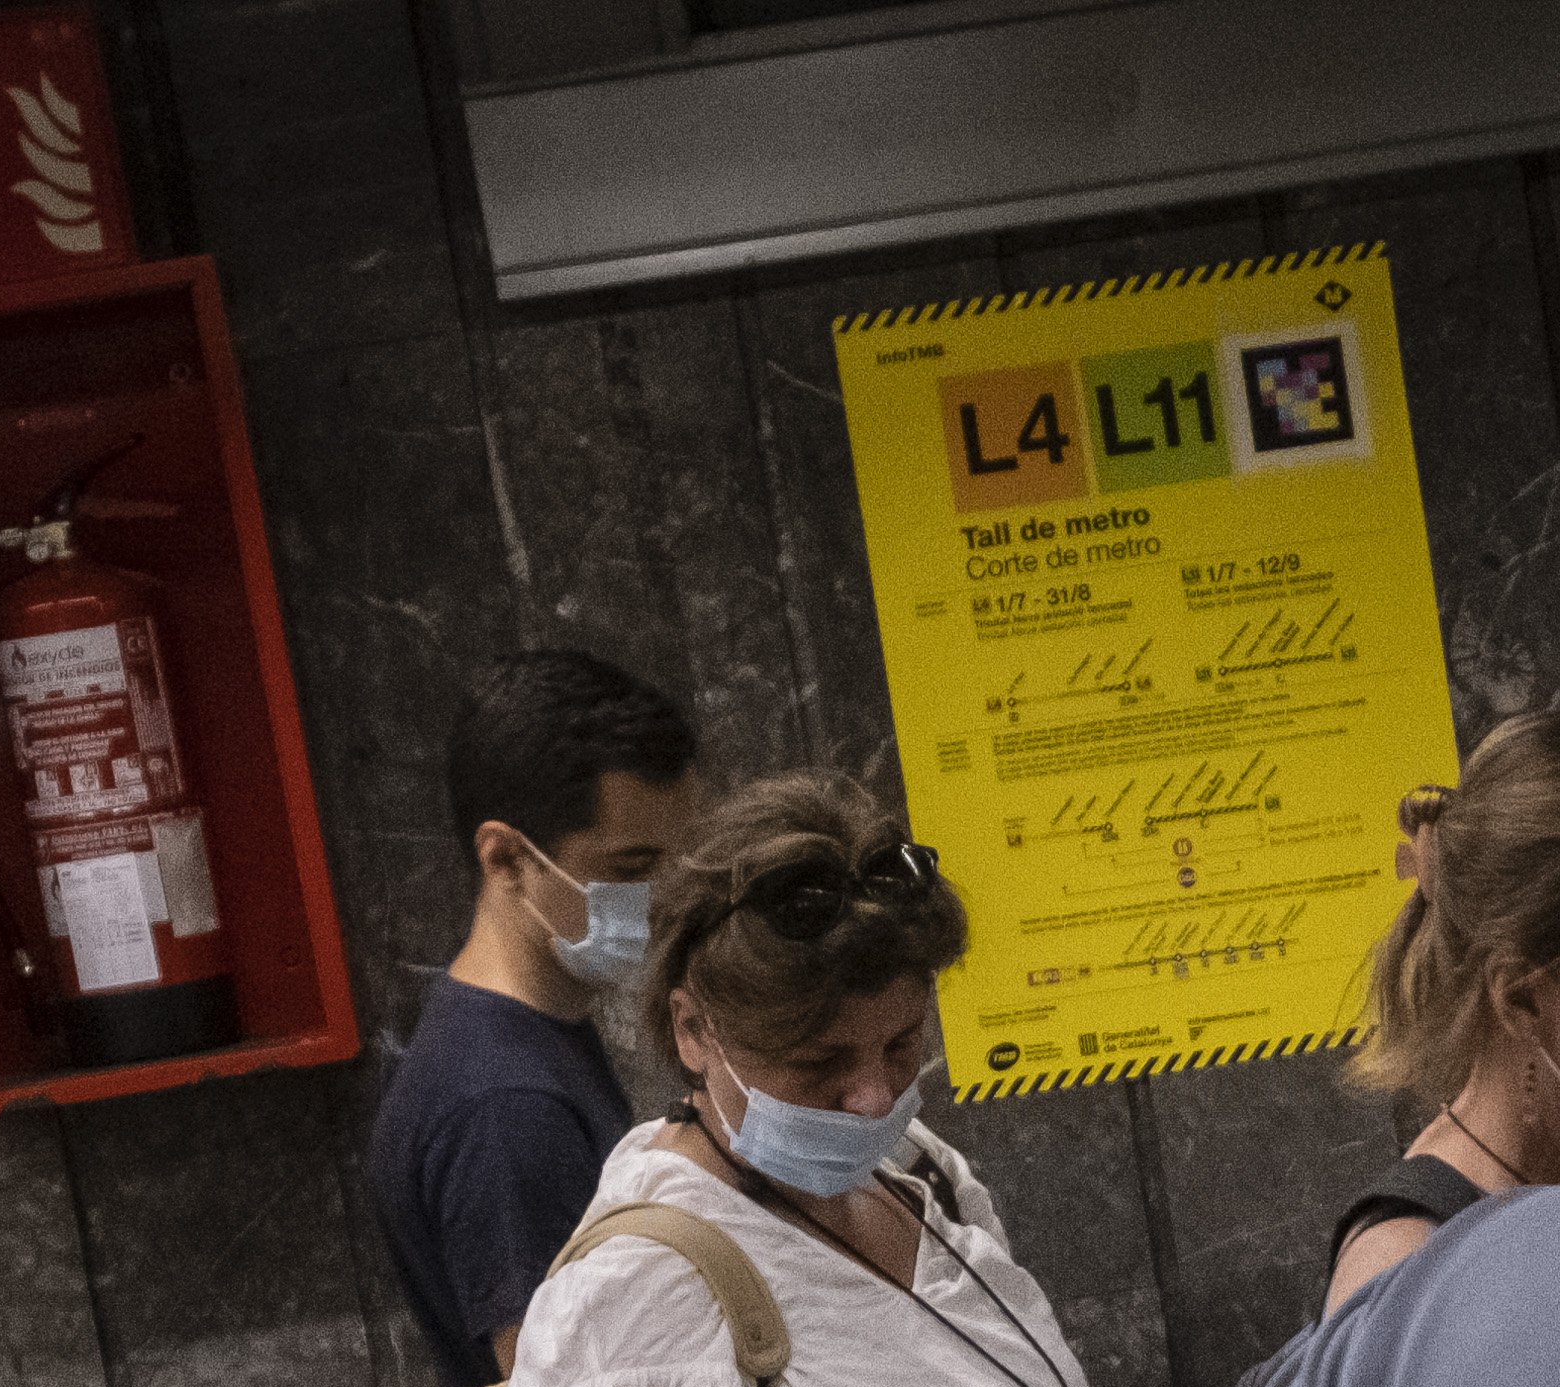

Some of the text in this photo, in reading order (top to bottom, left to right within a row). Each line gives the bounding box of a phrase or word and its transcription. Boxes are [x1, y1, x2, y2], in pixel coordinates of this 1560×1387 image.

[960, 393, 1070, 475] L4
[1095, 371, 1216, 457] L11
[961, 507, 1150, 550] Tall de metro
[965, 535, 1161, 580] Corte de metro
[1206, 562, 1236, 582] 1/7
[1258, 554, 1300, 575] 12/9
[997, 592, 1026, 613] 1/7
[1046, 584, 1092, 606] 31/8
